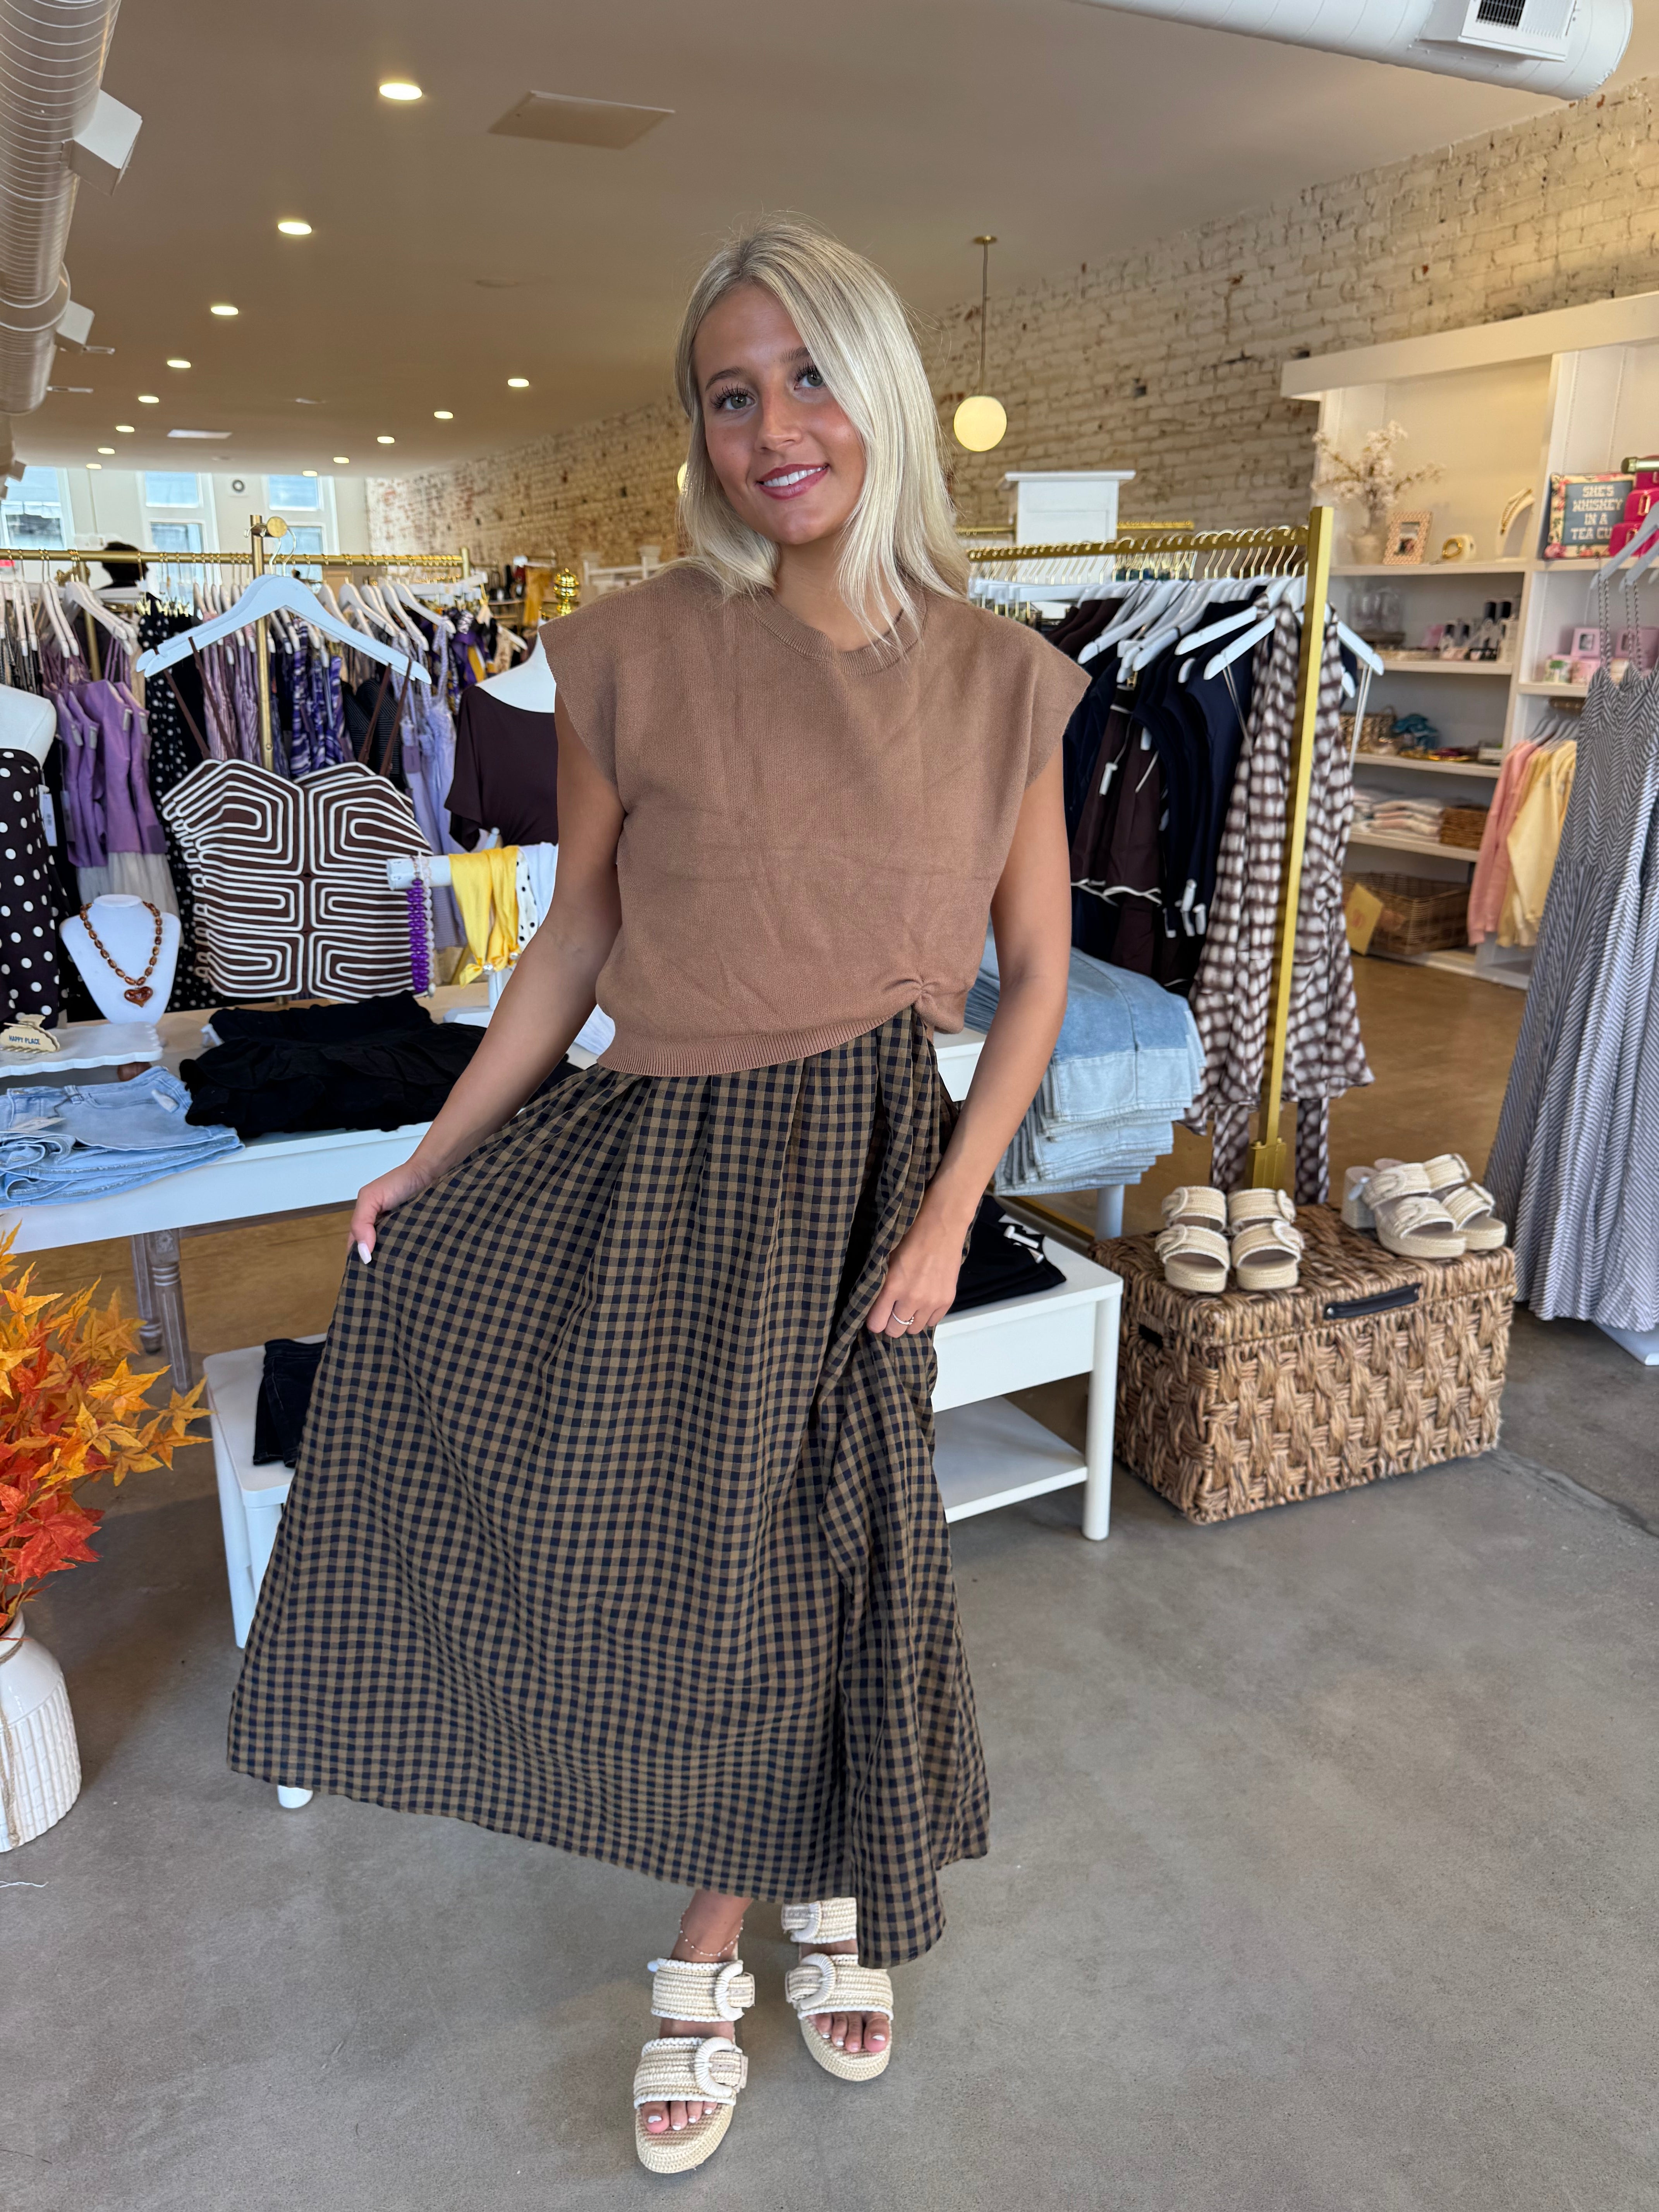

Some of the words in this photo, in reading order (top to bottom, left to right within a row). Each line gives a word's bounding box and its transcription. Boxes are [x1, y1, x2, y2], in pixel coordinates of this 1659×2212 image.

[1572, 498, 1623, 512] WHISKEY
[1584, 513, 1597, 526] IN
[1599, 513, 1608, 525] A
[1571, 527, 1594, 540] TEA
[1596, 526, 1613, 539] CU
